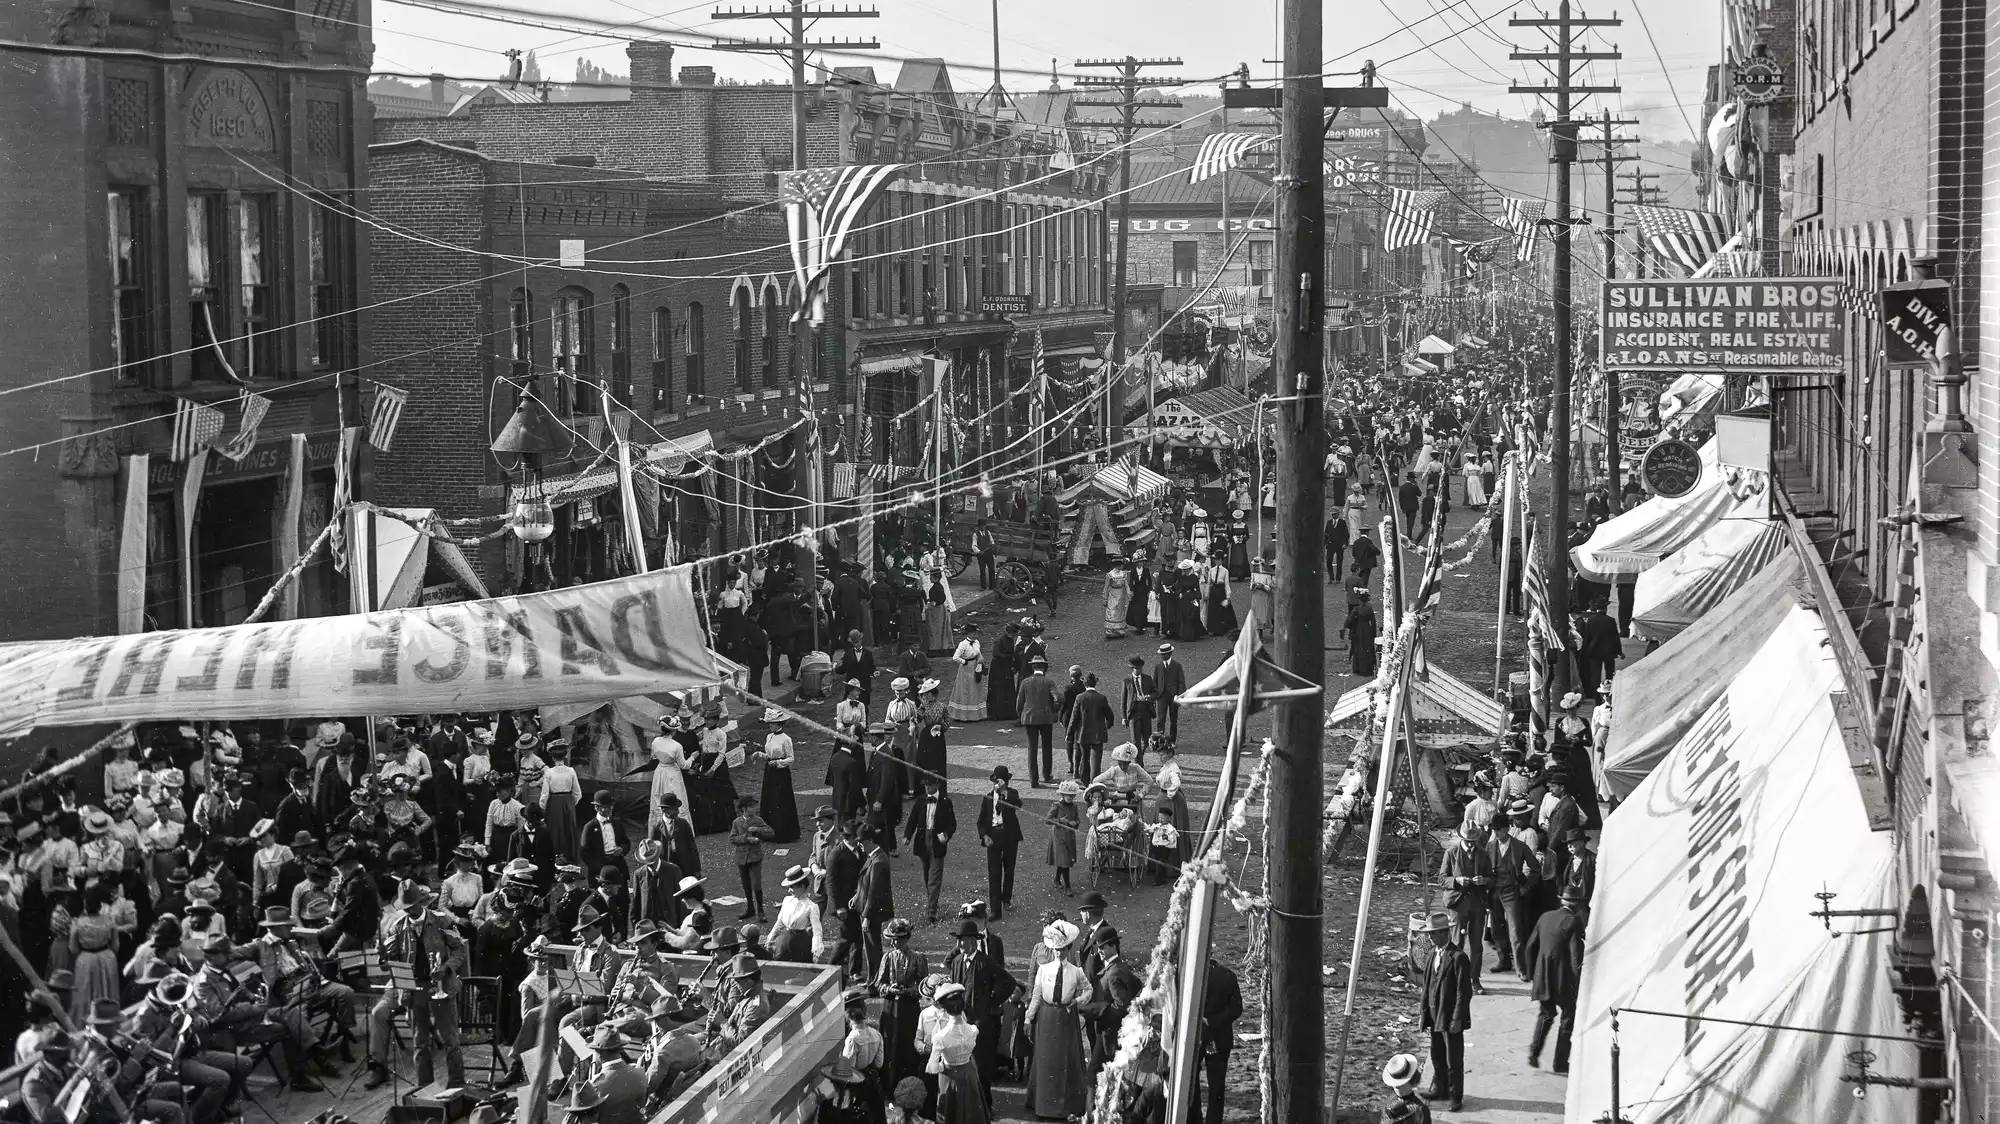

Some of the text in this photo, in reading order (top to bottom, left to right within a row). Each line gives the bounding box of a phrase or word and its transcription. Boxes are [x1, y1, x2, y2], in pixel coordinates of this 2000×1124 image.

[211, 115, 245, 137] 1890
[1610, 285, 1838, 307] SULLIVAN BROS
[983, 303, 1027, 311] DENTIST.
[1608, 312, 1842, 330] INSURANCE FIRE, LIFE,
[1615, 333, 1830, 348] ACCIDENT, REAL ESTATE
[1724, 351, 1799, 366] Reasonable
[1803, 352, 1843, 367] Rates
[1165, 402, 1181, 412] The
[1619, 434, 1658, 446] BEER
[1663, 454, 1684, 464] WATCH
[1688, 759, 1742, 884] SHOE
[1684, 844, 1756, 1058] STORE
